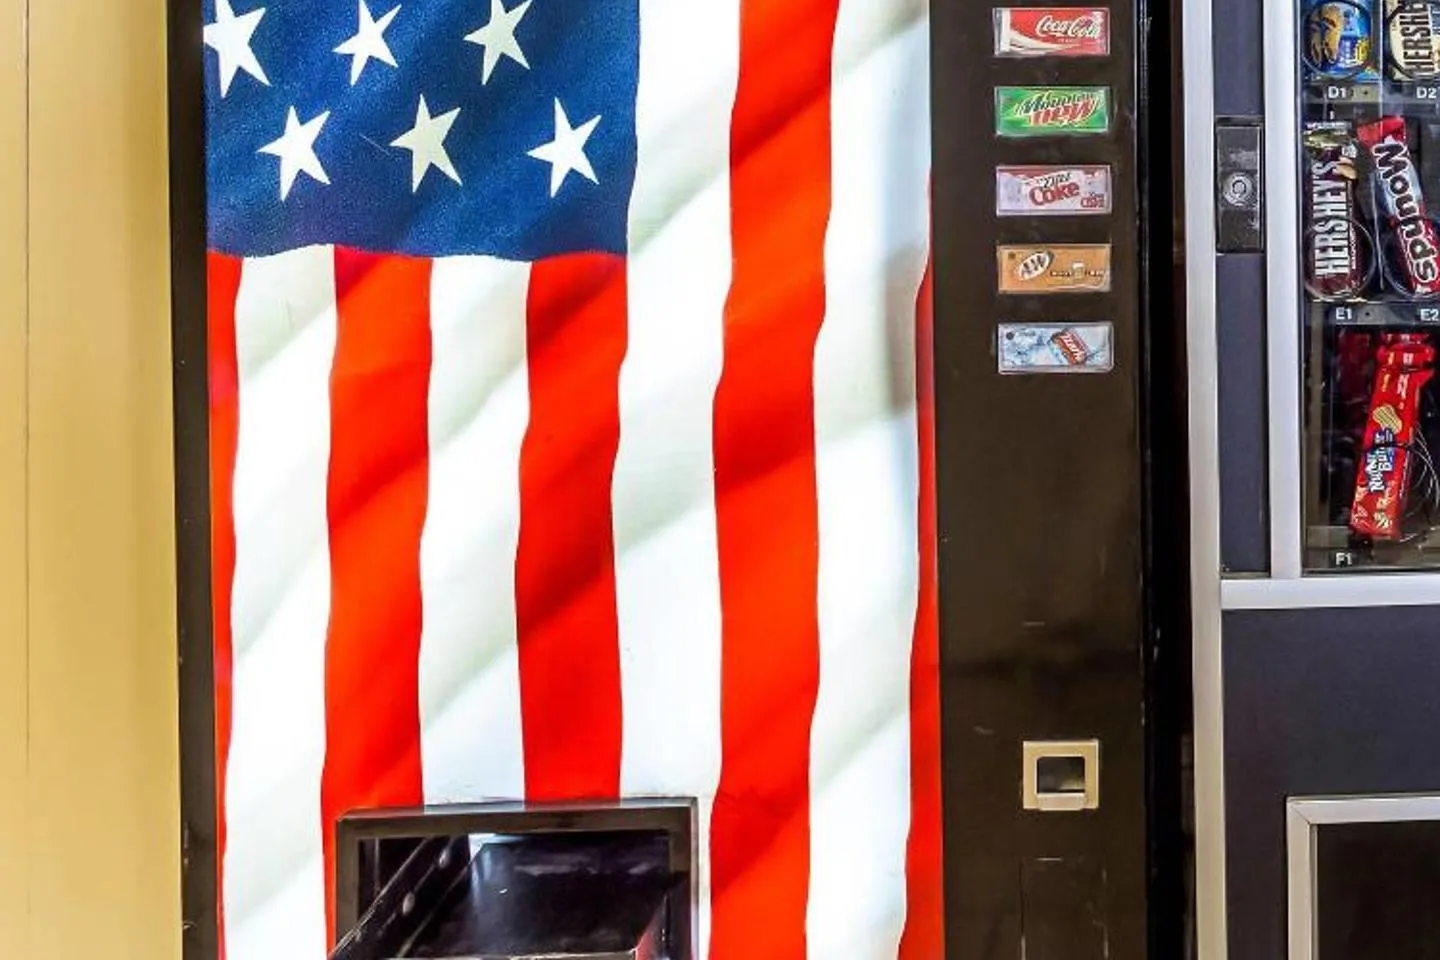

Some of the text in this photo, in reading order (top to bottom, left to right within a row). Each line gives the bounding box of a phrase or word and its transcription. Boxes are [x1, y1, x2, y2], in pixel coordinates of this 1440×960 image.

[1328, 86, 1347, 98] D1
[1416, 87, 1437, 99] D2
[1029, 182, 1080, 206] Coke
[1311, 159, 1349, 277] HERSHEY'S
[1371, 142, 1438, 284] Mounds
[1335, 308, 1353, 320] E1
[1420, 309, 1439, 321] E2
[1336, 553, 1353, 566] F1
